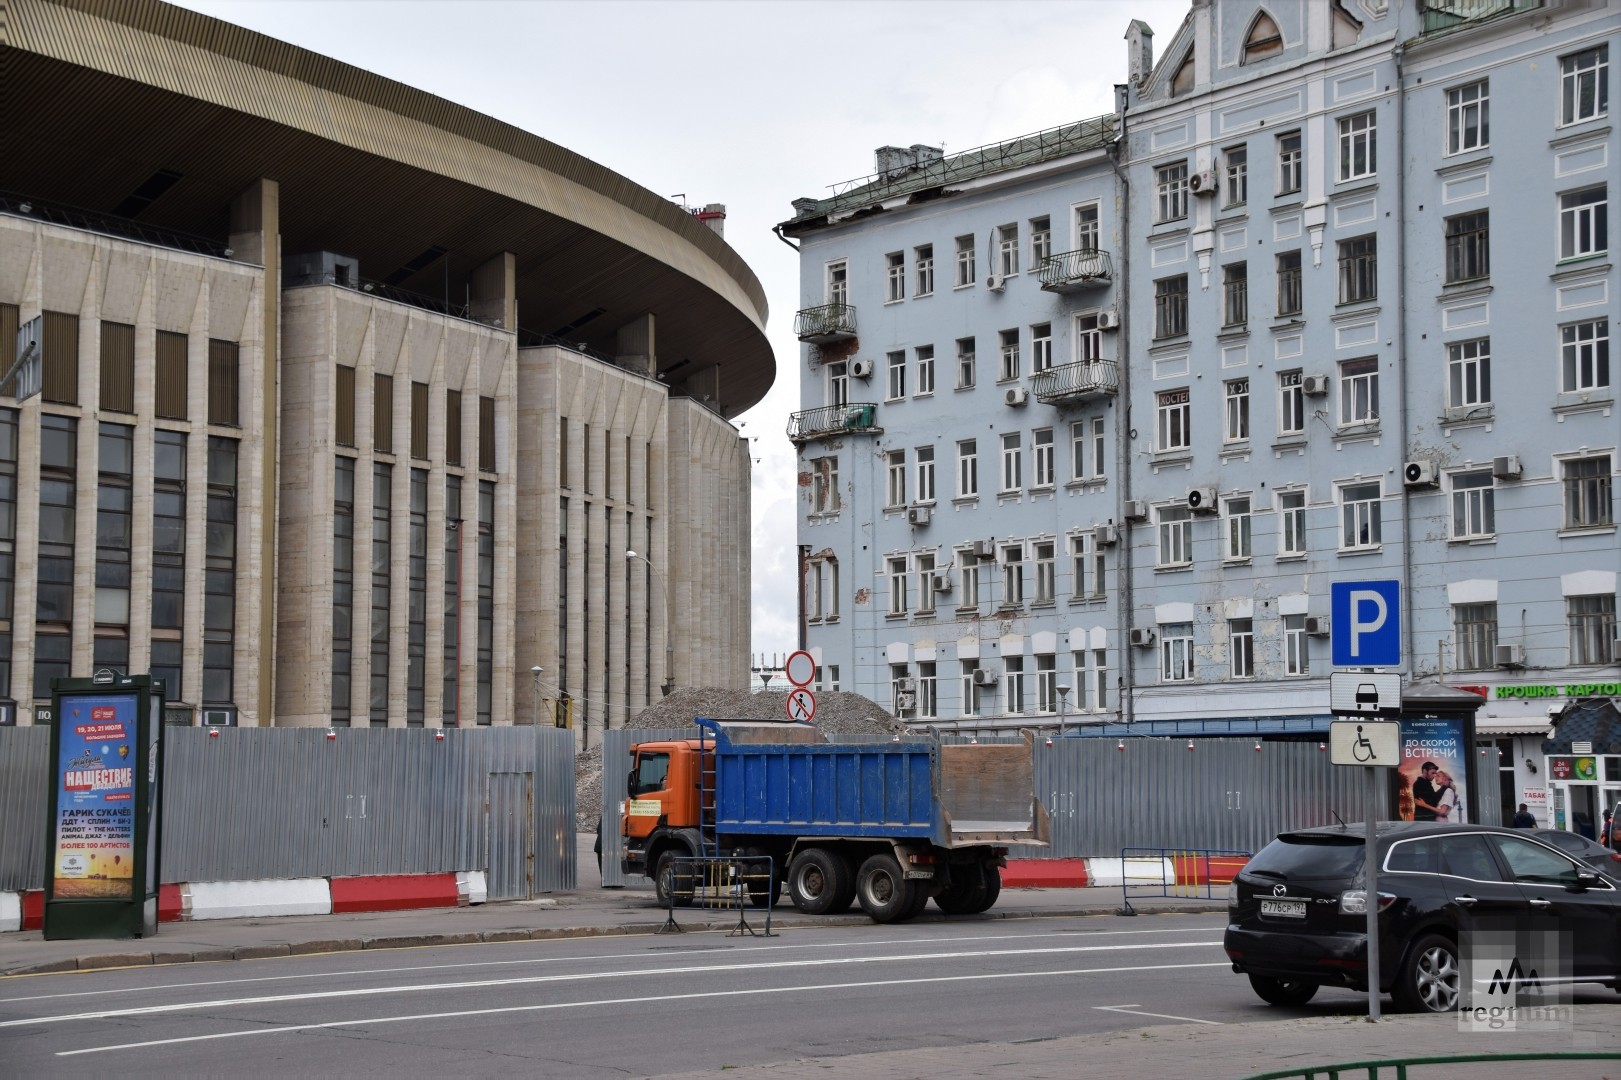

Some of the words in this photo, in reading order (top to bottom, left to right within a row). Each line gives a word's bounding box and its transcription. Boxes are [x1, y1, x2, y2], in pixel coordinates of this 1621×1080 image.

[1350, 590, 1388, 657] P
[1496, 686, 1558, 698] КРОШКА
[37, 710, 51, 720] ПО
[1406, 739, 1419, 747] ДО
[1420, 738, 1456, 747] СКОРОЙ
[1405, 748, 1457, 758] ВСТРЕЧИ
[66, 768, 132, 787] НАШЕСТВИЕ
[62, 809, 94, 817] ГАРИК
